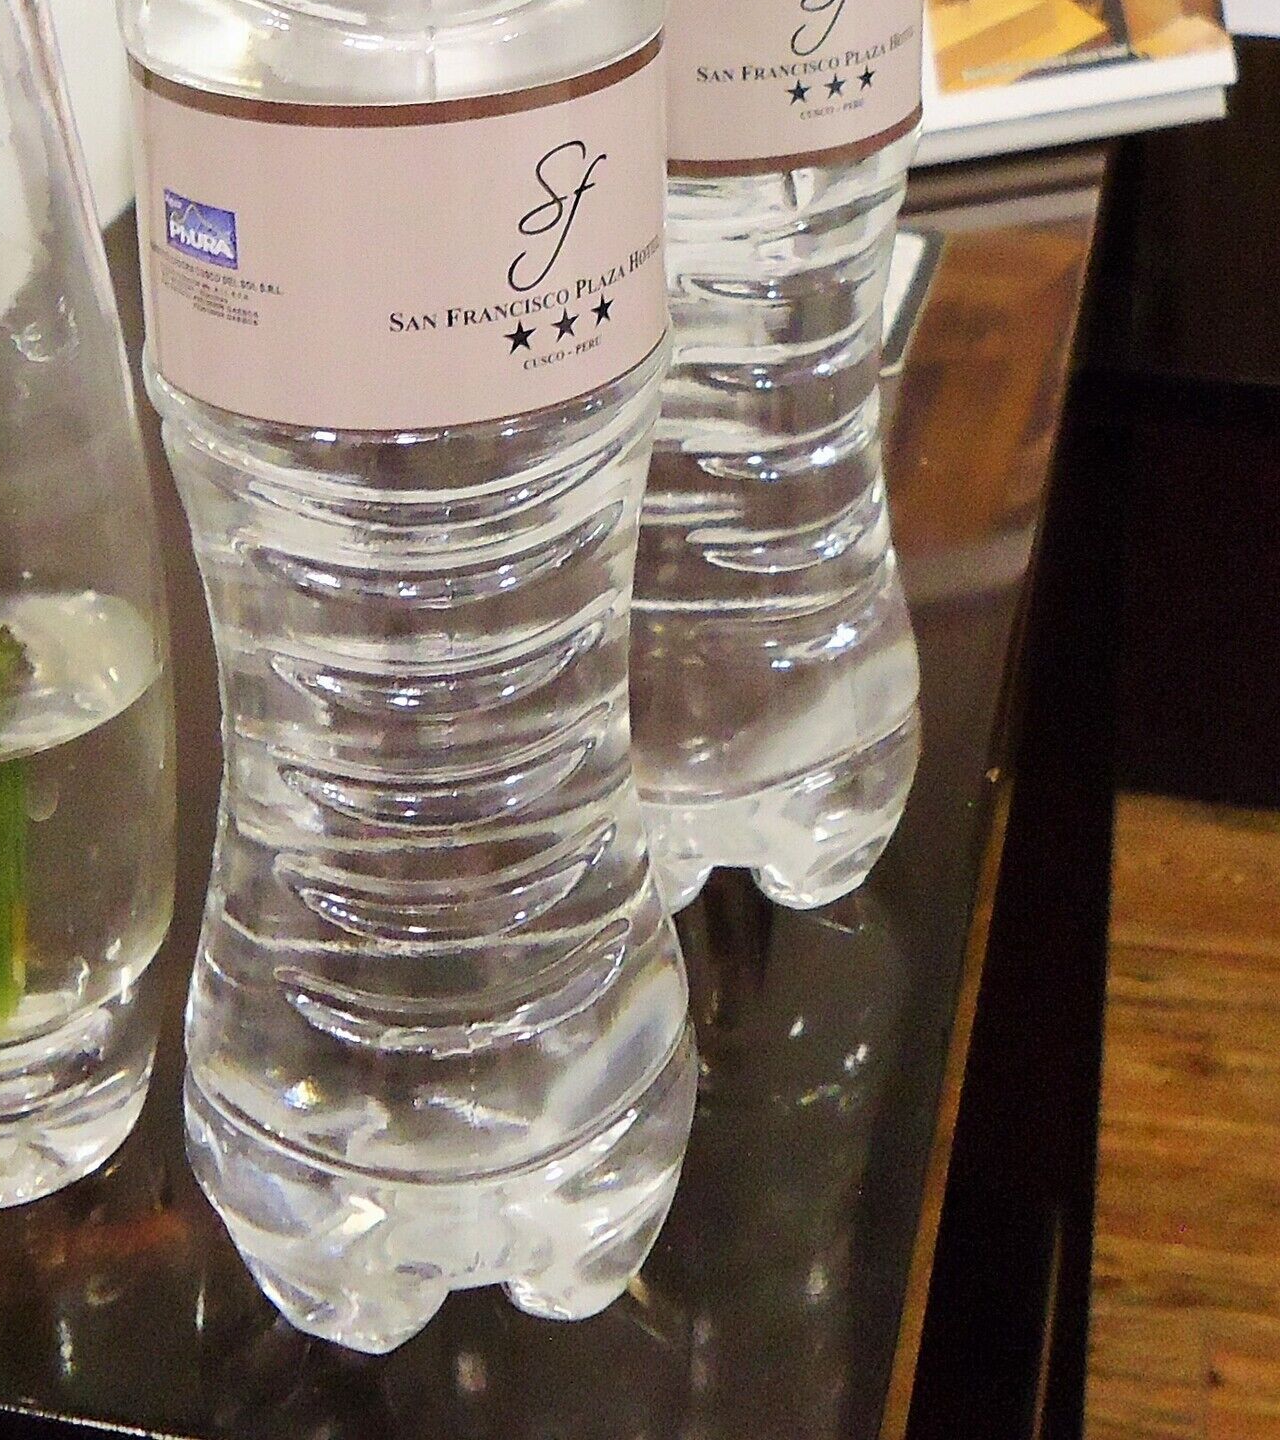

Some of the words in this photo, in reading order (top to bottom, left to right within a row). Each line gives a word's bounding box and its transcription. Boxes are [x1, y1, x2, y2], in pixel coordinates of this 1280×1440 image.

[696, 65, 734, 83] SAN
[742, 58, 840, 81] FRANCISCO
[845, 44, 886, 67] PLAZA
[389, 312, 437, 333] SAN
[447, 289, 569, 328] FRANCISCO
[576, 265, 625, 299] PLAZA
[523, 350, 565, 370] CUSCO
